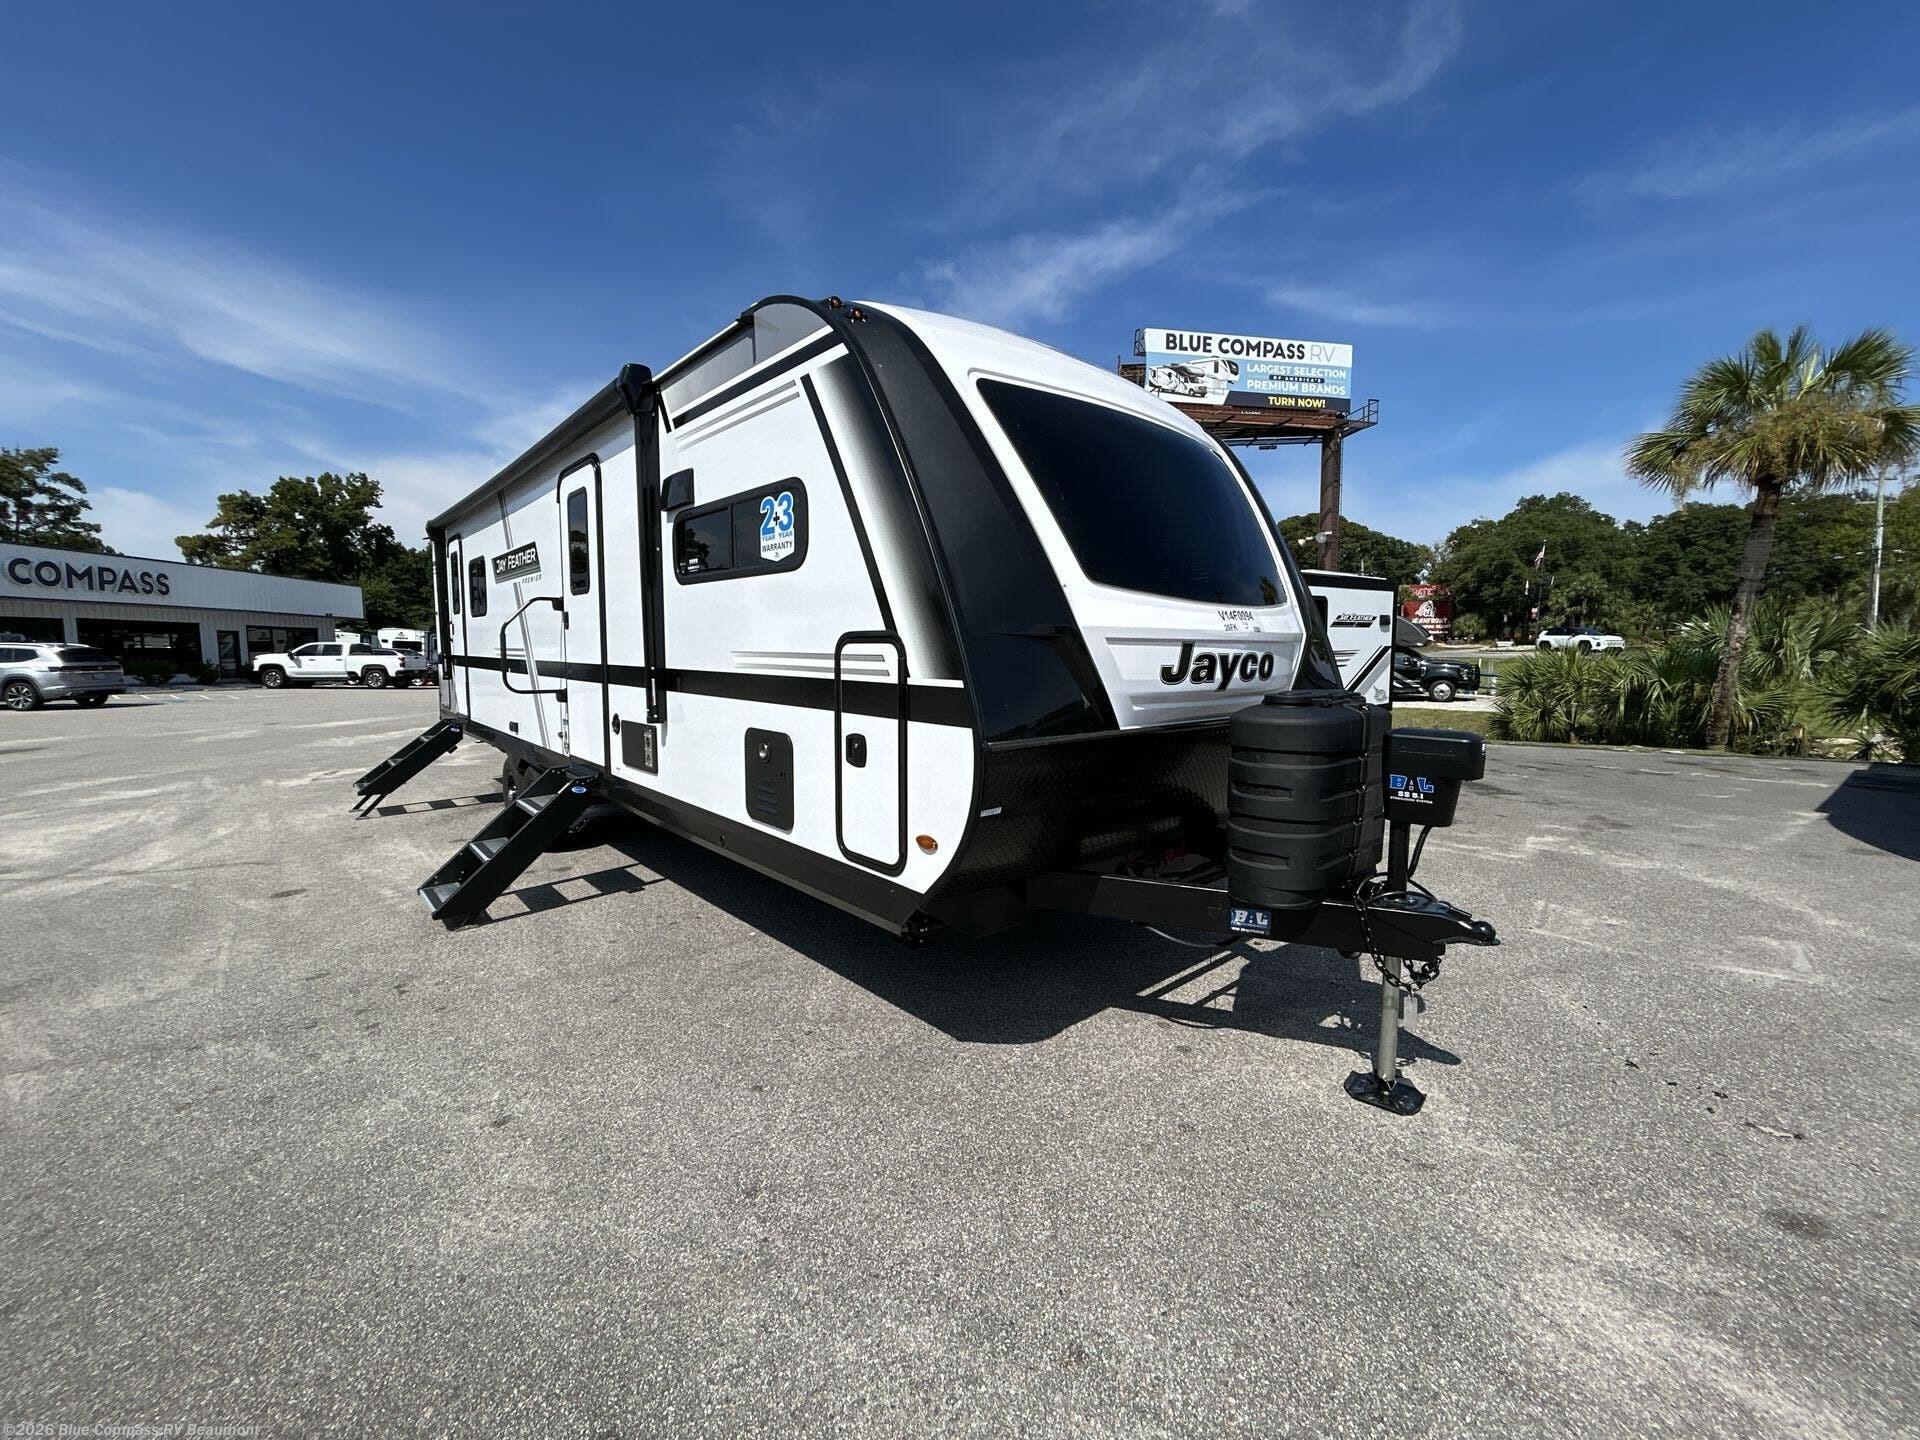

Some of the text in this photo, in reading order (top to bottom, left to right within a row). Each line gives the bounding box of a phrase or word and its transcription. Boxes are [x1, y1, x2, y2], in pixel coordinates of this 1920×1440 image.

[1165, 333, 1336, 362] BLUE COMPASS RV
[1246, 363, 1346, 379] LARGEST SELECTION
[1246, 379, 1346, 395] PREMIUM BRANDS
[1268, 396, 1326, 408] TURN NOW!
[762, 531, 793, 542] YEAR YEAR
[762, 541, 793, 552] WARRANTY
[496, 548, 536, 573] JAY FEATHER
[8, 557, 170, 596] COMPASS
[1160, 640, 1274, 692] Jayco
